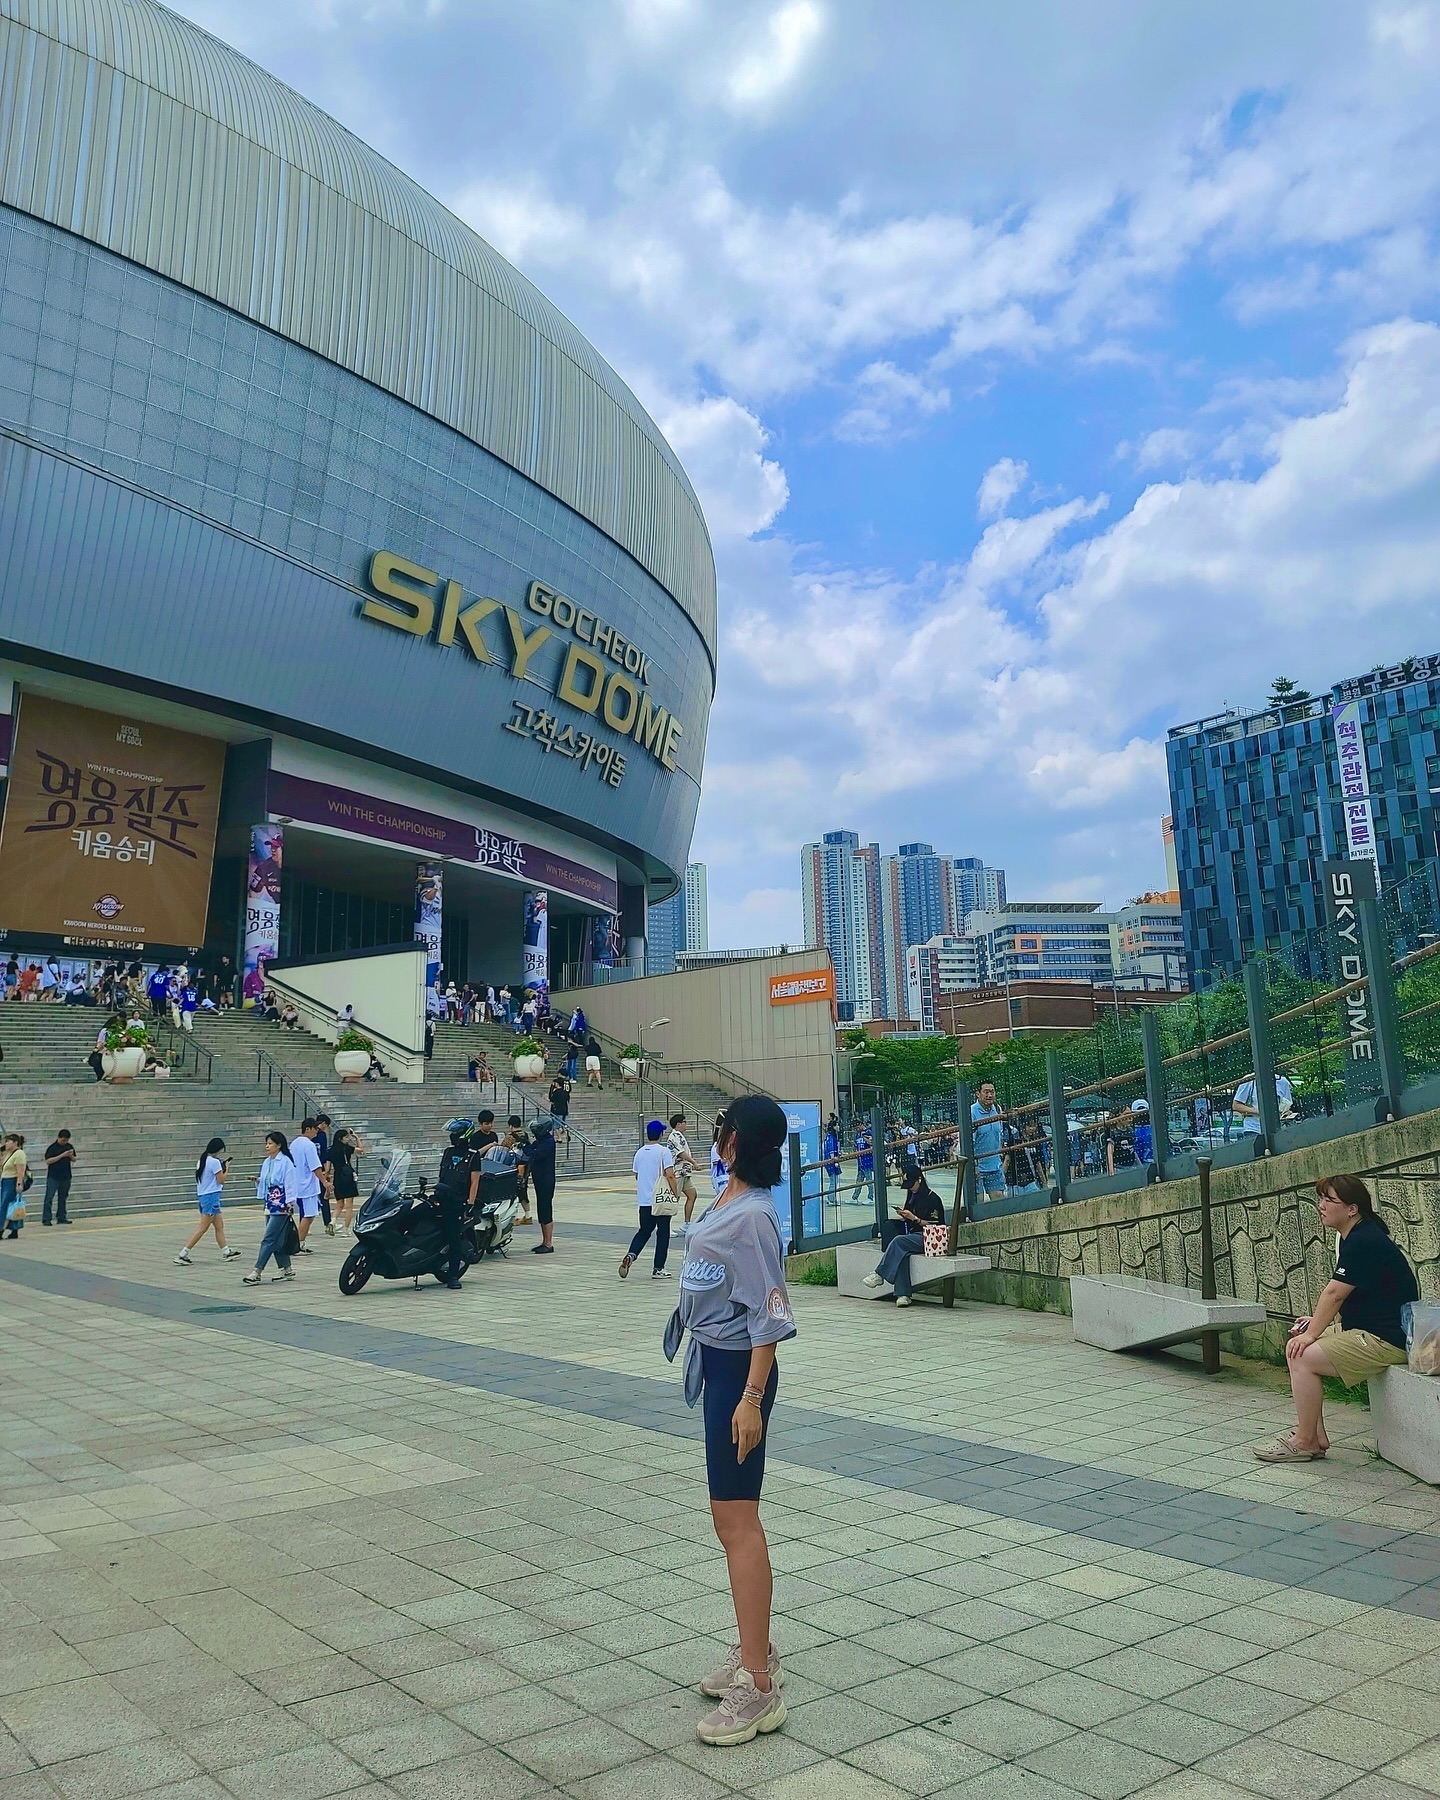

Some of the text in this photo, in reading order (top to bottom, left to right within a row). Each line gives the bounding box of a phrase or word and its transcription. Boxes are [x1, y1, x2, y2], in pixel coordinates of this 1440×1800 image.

[361, 549, 684, 773] SKY DOME
[529, 580, 653, 686] GOCHEOK
[87, 762, 164, 784] WIN THE CHAMPIONSHIP
[503, 700, 629, 789] 고척스카이돔
[327, 800, 447, 841] WIN THE CHAMPIONSHIP
[545, 863, 602, 894] WIN THE CHAMPIONSHIP
[1331, 872, 1373, 1061] SKY DOME
